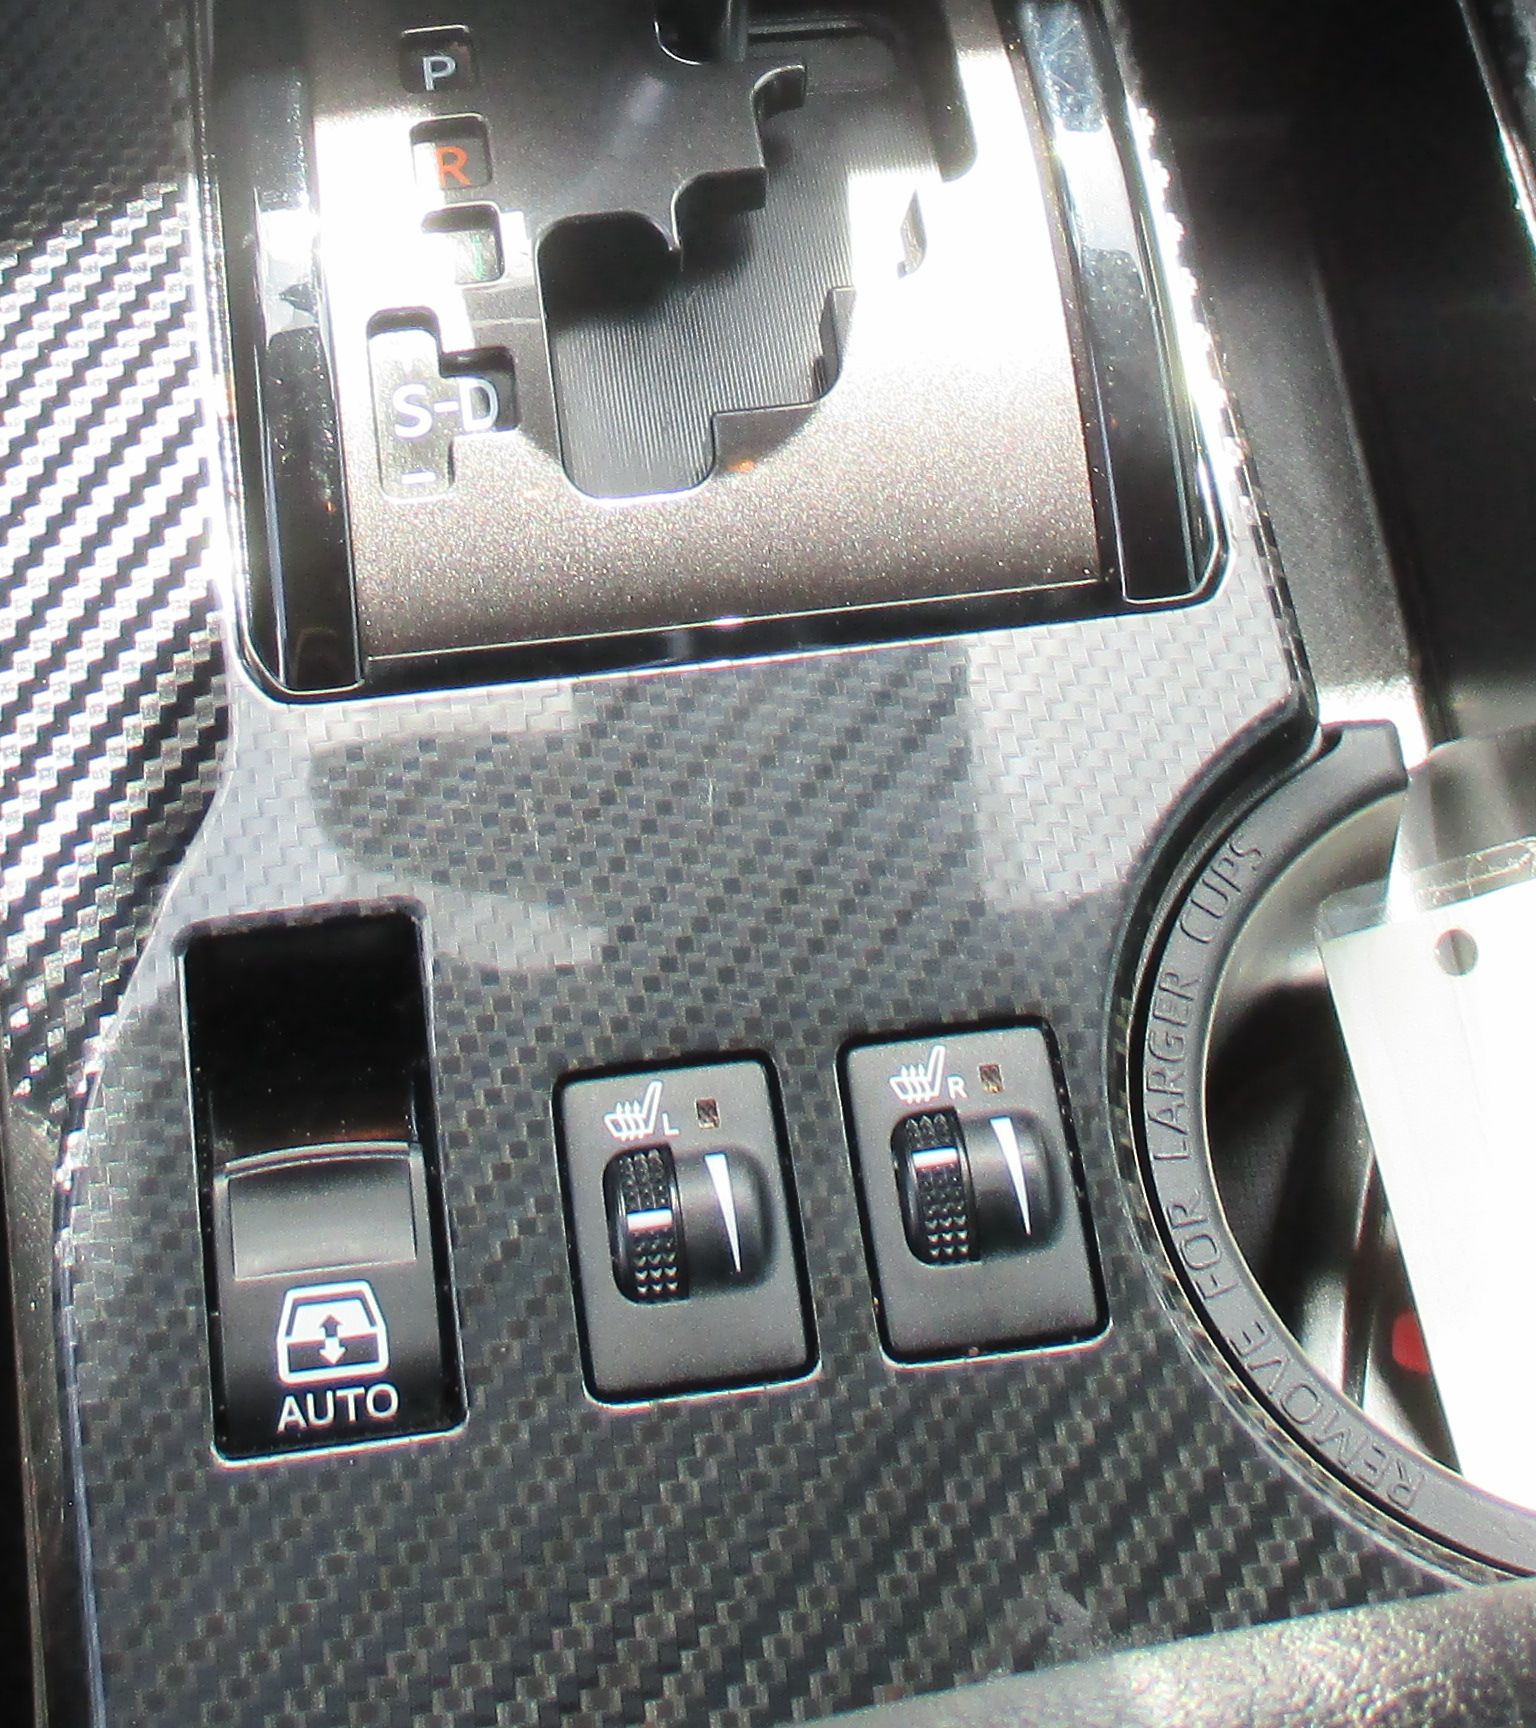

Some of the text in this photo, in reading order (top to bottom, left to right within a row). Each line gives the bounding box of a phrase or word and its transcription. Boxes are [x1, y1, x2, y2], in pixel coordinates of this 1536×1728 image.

[421, 55, 456, 91] P
[435, 145, 472, 189] R
[946, 1074, 968, 1100] R
[661, 1112, 681, 1137] L
[1145, 838, 1427, 1511] REMOVE FOR LARGER CUPS
[276, 1381, 400, 1435] AUTO
